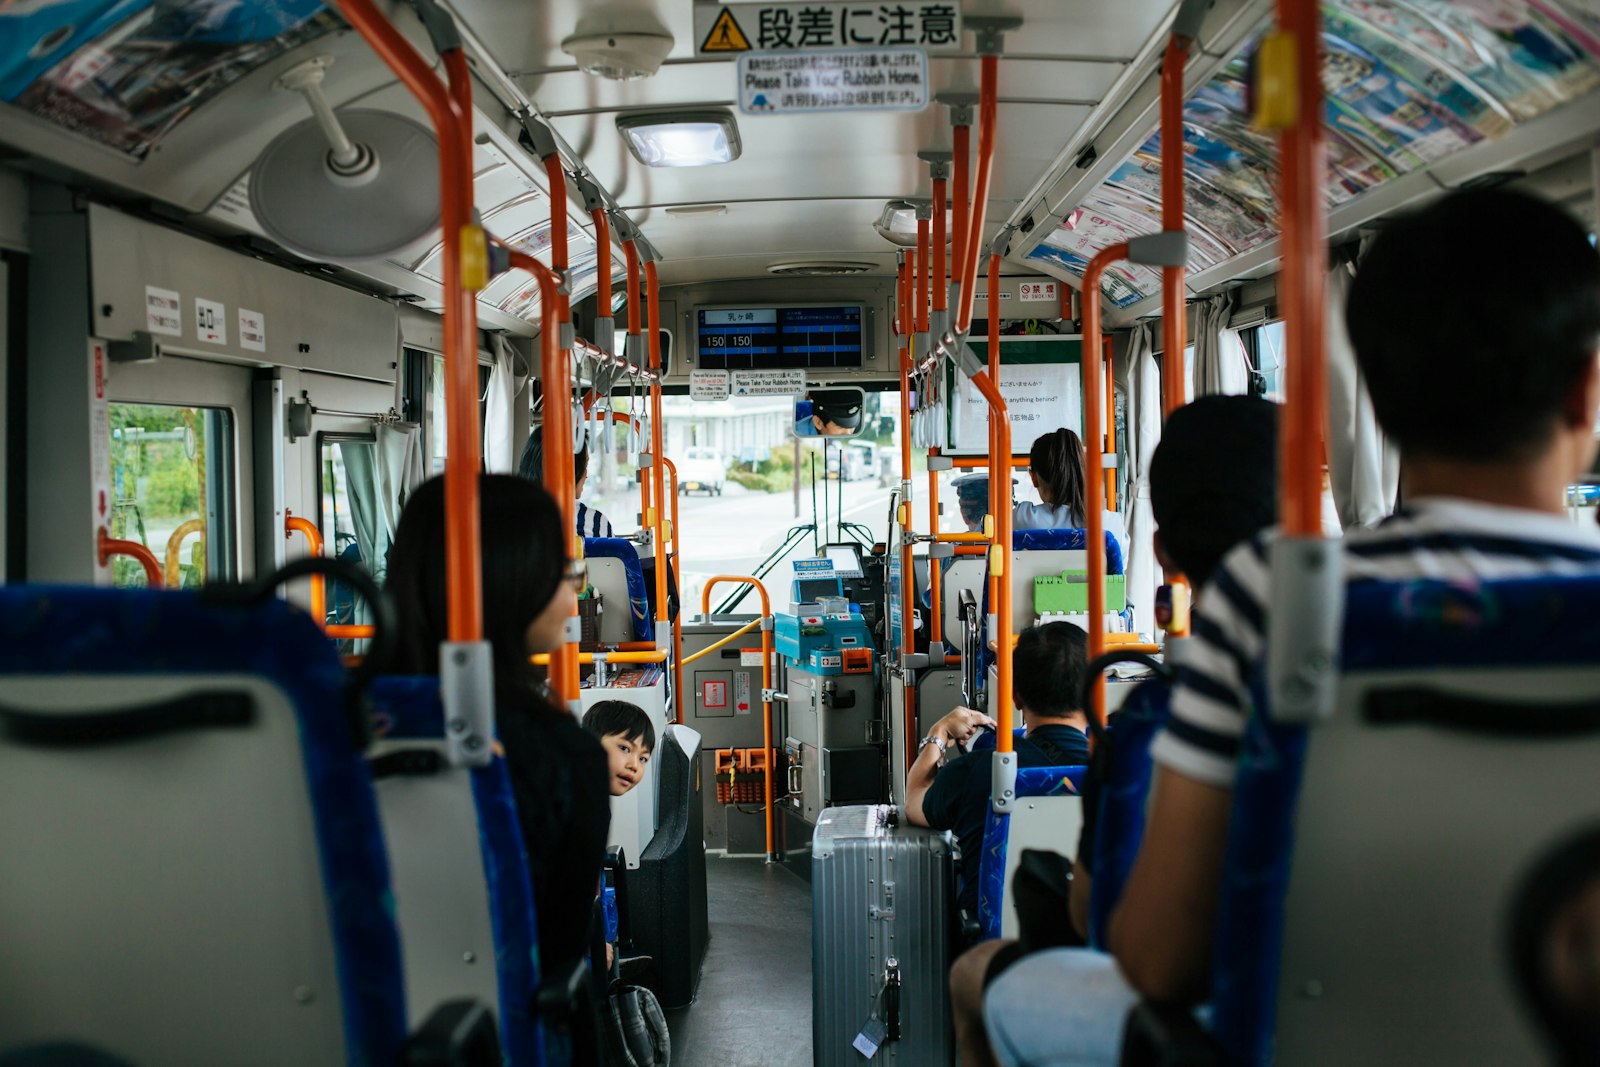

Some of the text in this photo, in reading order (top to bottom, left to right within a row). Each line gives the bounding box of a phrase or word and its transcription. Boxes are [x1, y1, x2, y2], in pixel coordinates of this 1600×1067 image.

[757, 4, 957, 49] 段差に注意
[745, 69, 922, 89] Please Take Your Rubbish Home.
[707, 335, 750, 347] 150 150
[1009, 396, 1034, 404] anything
